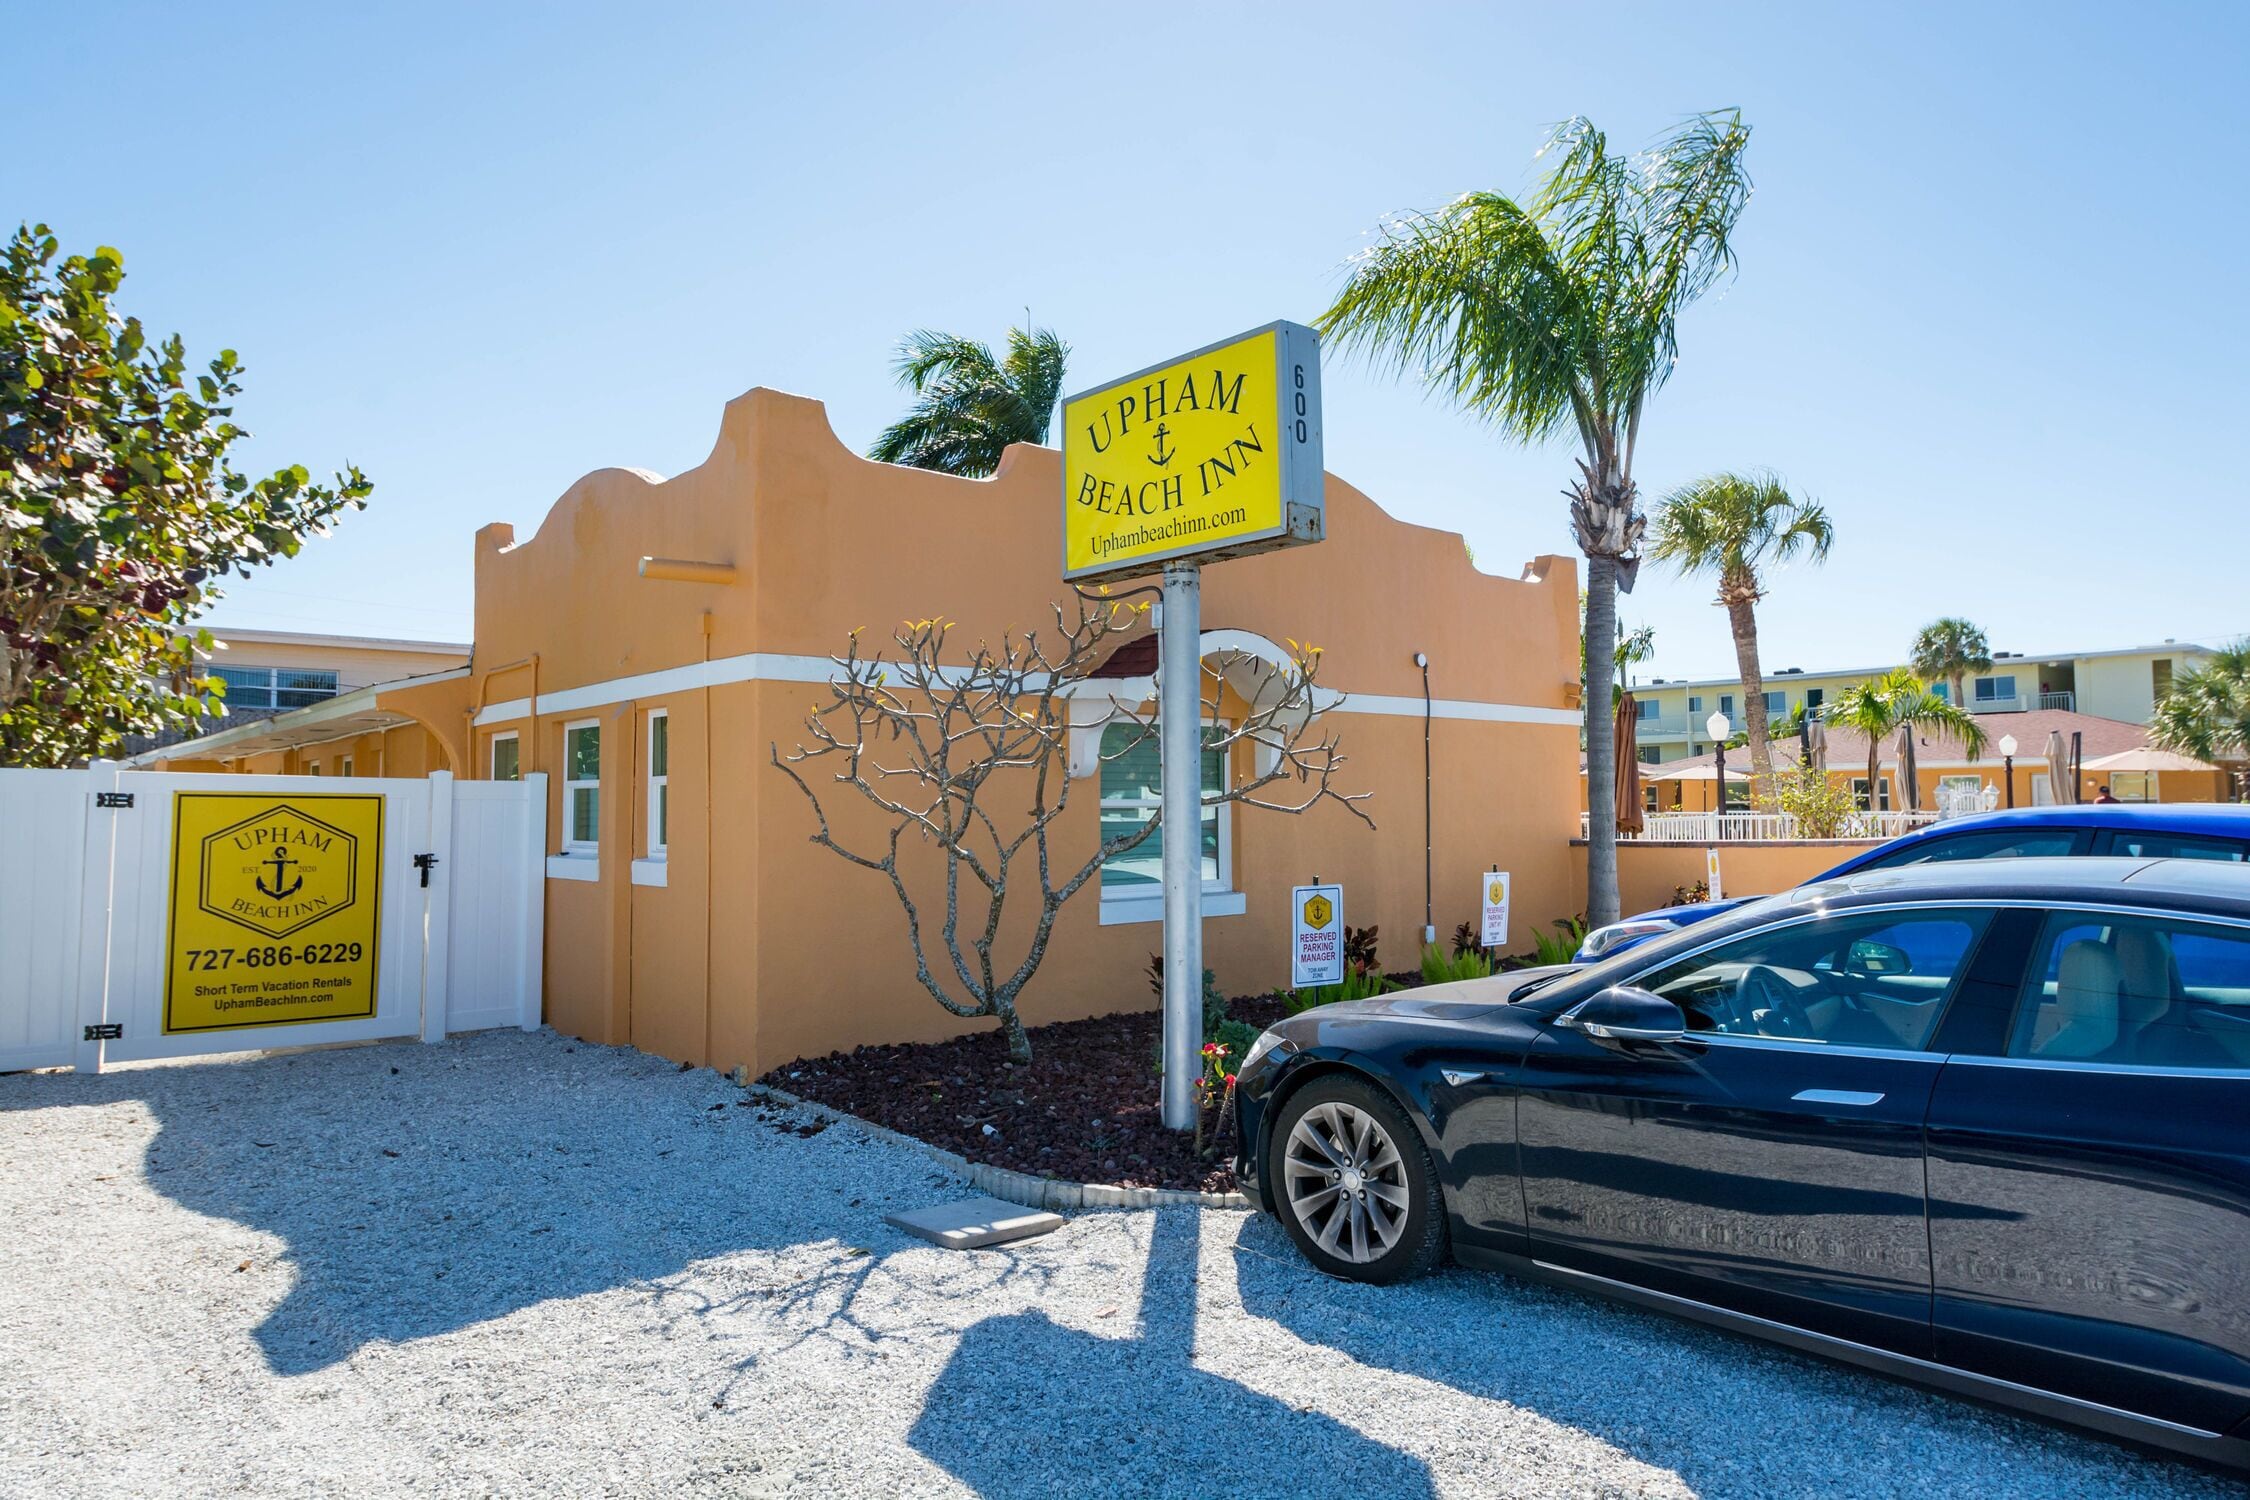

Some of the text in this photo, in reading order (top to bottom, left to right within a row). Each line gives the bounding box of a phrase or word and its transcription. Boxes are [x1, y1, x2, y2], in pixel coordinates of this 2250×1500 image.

[1086, 369, 1248, 454] UPHAM
[1293, 363, 1308, 445] 600
[1076, 422, 1264, 517] BEACH INN
[1090, 506, 1247, 557] Uphambeachinn.com
[233, 826, 333, 853] UPHAM
[297, 865, 317, 873] 2020
[230, 895, 329, 918] BEACH INN
[1300, 931, 1337, 943] RESERVED
[1303, 942, 1334, 952] PARKING
[186, 942, 363, 971] 727-686-6229
[1300, 951, 1336, 963] MANAGER
[194, 976, 353, 997] Short Term Vacation Rentals
[214, 992, 334, 1012] UphamBeachInn.com
